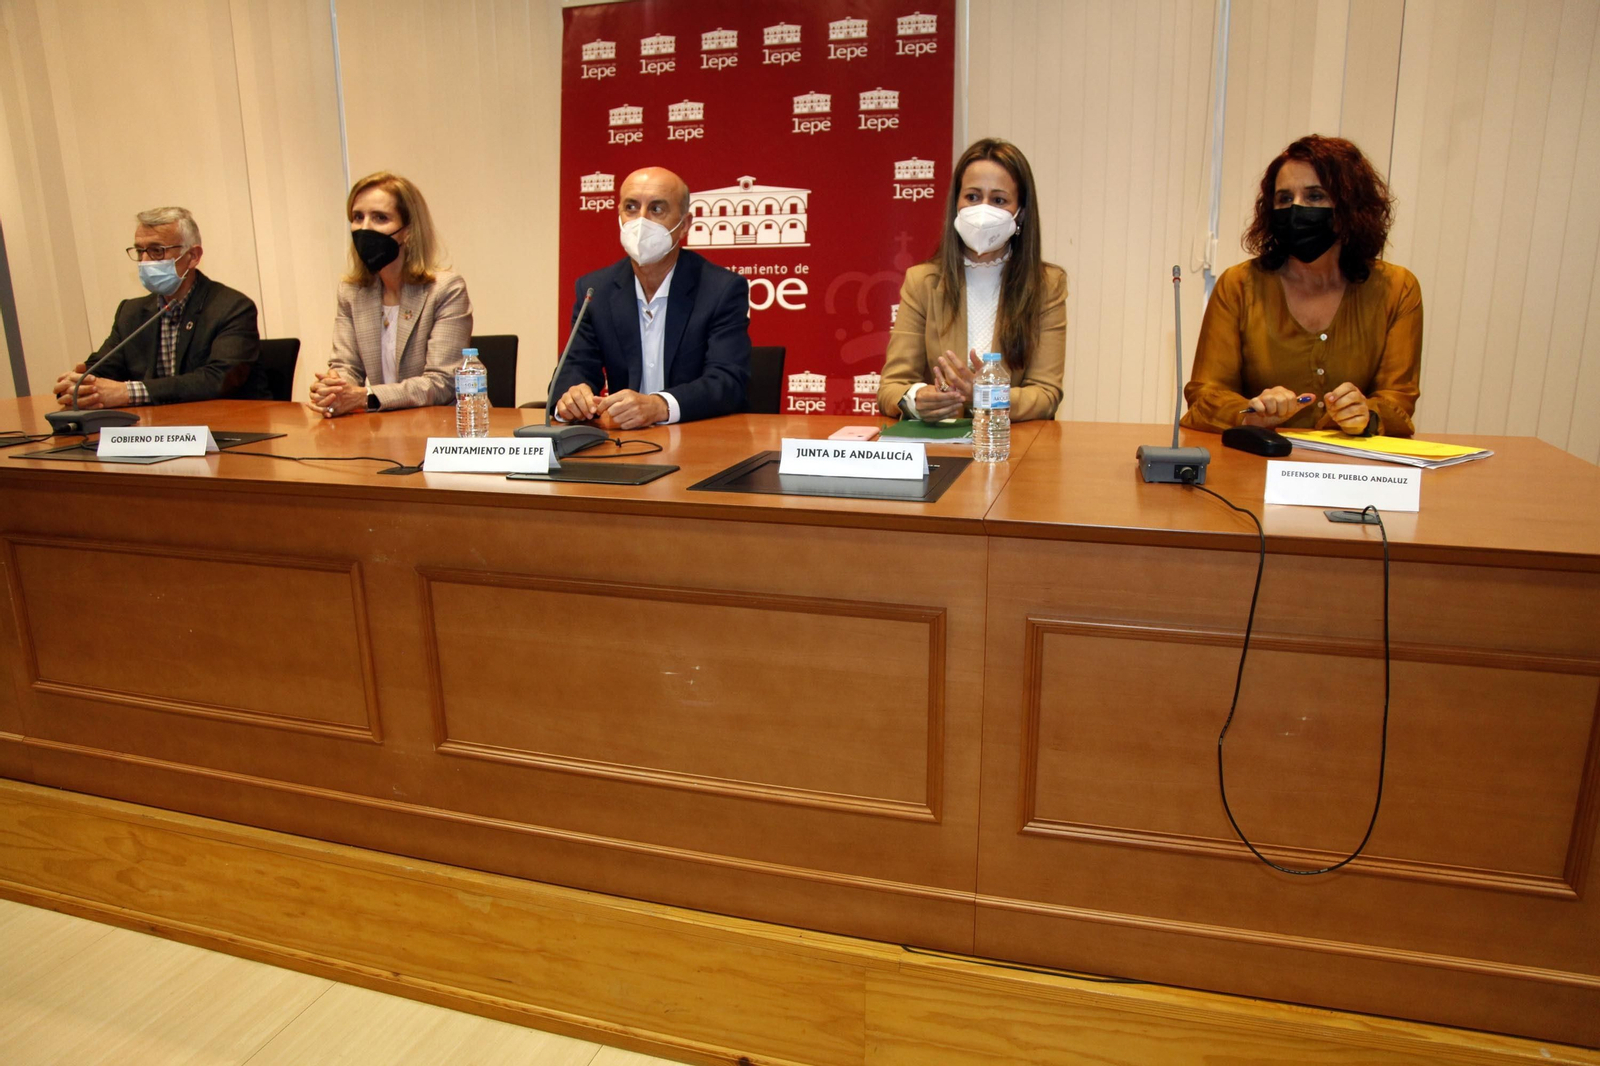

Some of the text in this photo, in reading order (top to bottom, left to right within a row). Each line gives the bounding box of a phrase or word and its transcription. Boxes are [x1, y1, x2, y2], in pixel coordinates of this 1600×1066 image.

[827, 44, 868, 61] lepe
[895, 39, 937, 57] lepe
[700, 54, 738, 70] lepe
[762, 49, 801, 66] lepe
[581, 64, 616, 80] lepe
[639, 59, 676, 75] lepe
[792, 118, 831, 135] lepe
[858, 114, 899, 132] lepe
[608, 129, 643, 146] lepe
[667, 125, 704, 142] lepe
[893, 183, 935, 202] lepe
[579, 195, 615, 213] lepe
[725, 263, 809, 275] tamiento de
[747, 277, 808, 319] pe
[787, 396, 826, 414] lepe
[852, 397, 880, 416] lep
[111, 435, 152, 443] GOBIERNO
[166, 433, 197, 442] ESPAÑA
[432, 446, 544, 455] AYUNTAMIENTO DE LEPE
[796, 448, 913, 461] JUNTA DE ANDALUCÍA
[1281, 470, 1320, 479] DEFENSOR
[1338, 474, 1368, 482] PUEBLO
[1370, 476, 1408, 485] ANDALUZ
